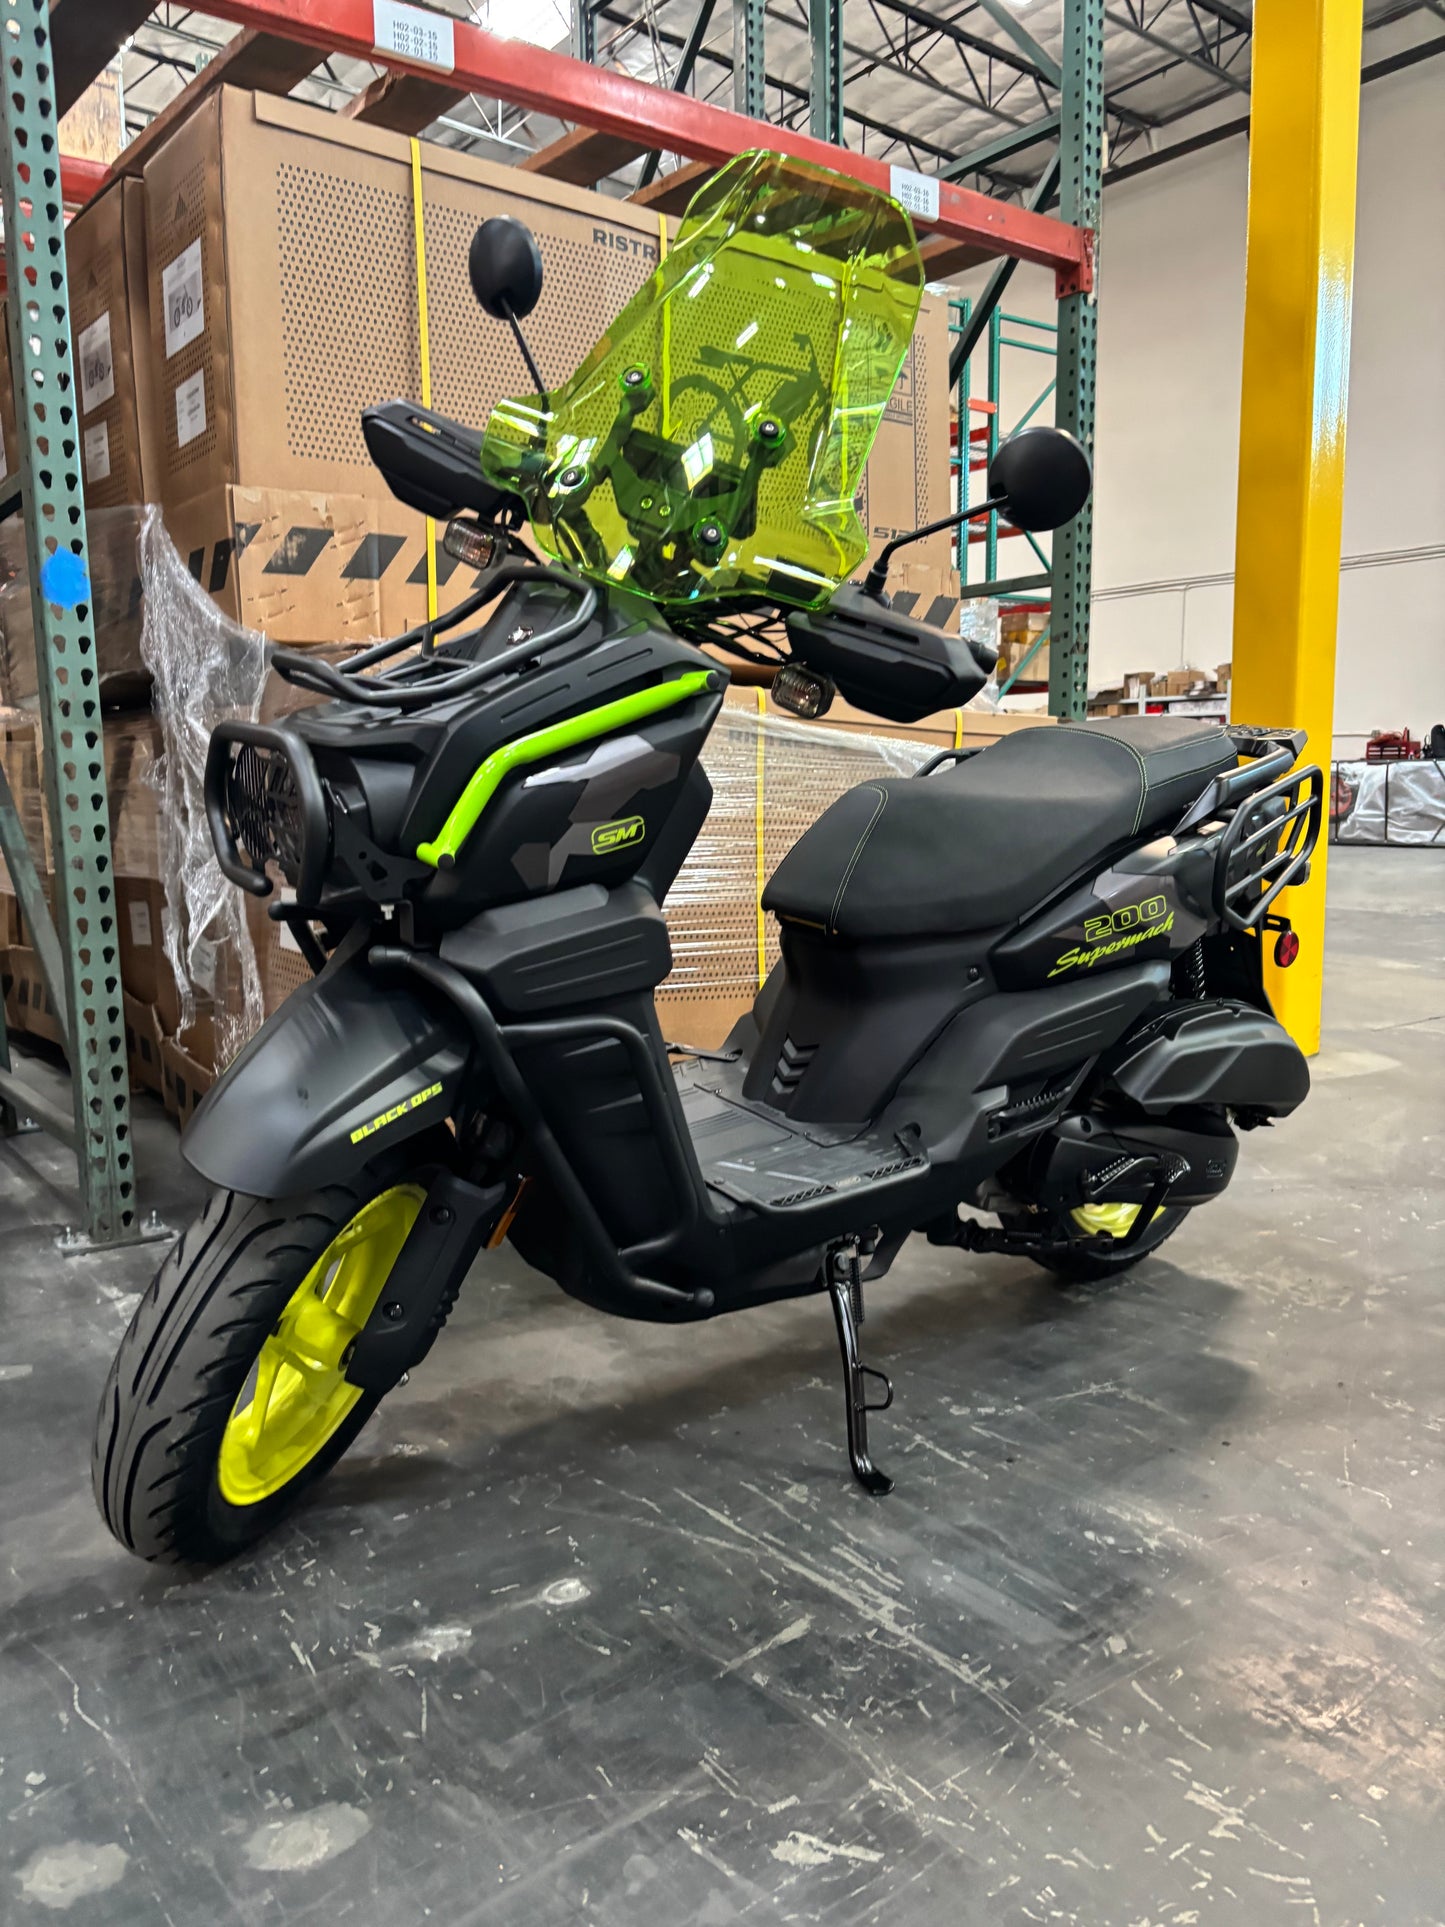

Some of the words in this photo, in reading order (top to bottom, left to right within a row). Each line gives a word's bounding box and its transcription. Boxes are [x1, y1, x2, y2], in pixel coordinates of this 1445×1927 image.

[392, 20, 437, 40] H02-03-15
[393, 31, 438, 50] H02-02-15
[593, 228, 657, 262] RISTR
[889, 397, 913, 412] GILE
[595, 822, 642, 848] SM
[1084, 895, 1166, 942] 200
[1047, 911, 1175, 978] Supermach
[350, 1101, 408, 1145] BLACK
[410, 1081, 443, 1108] OPS
